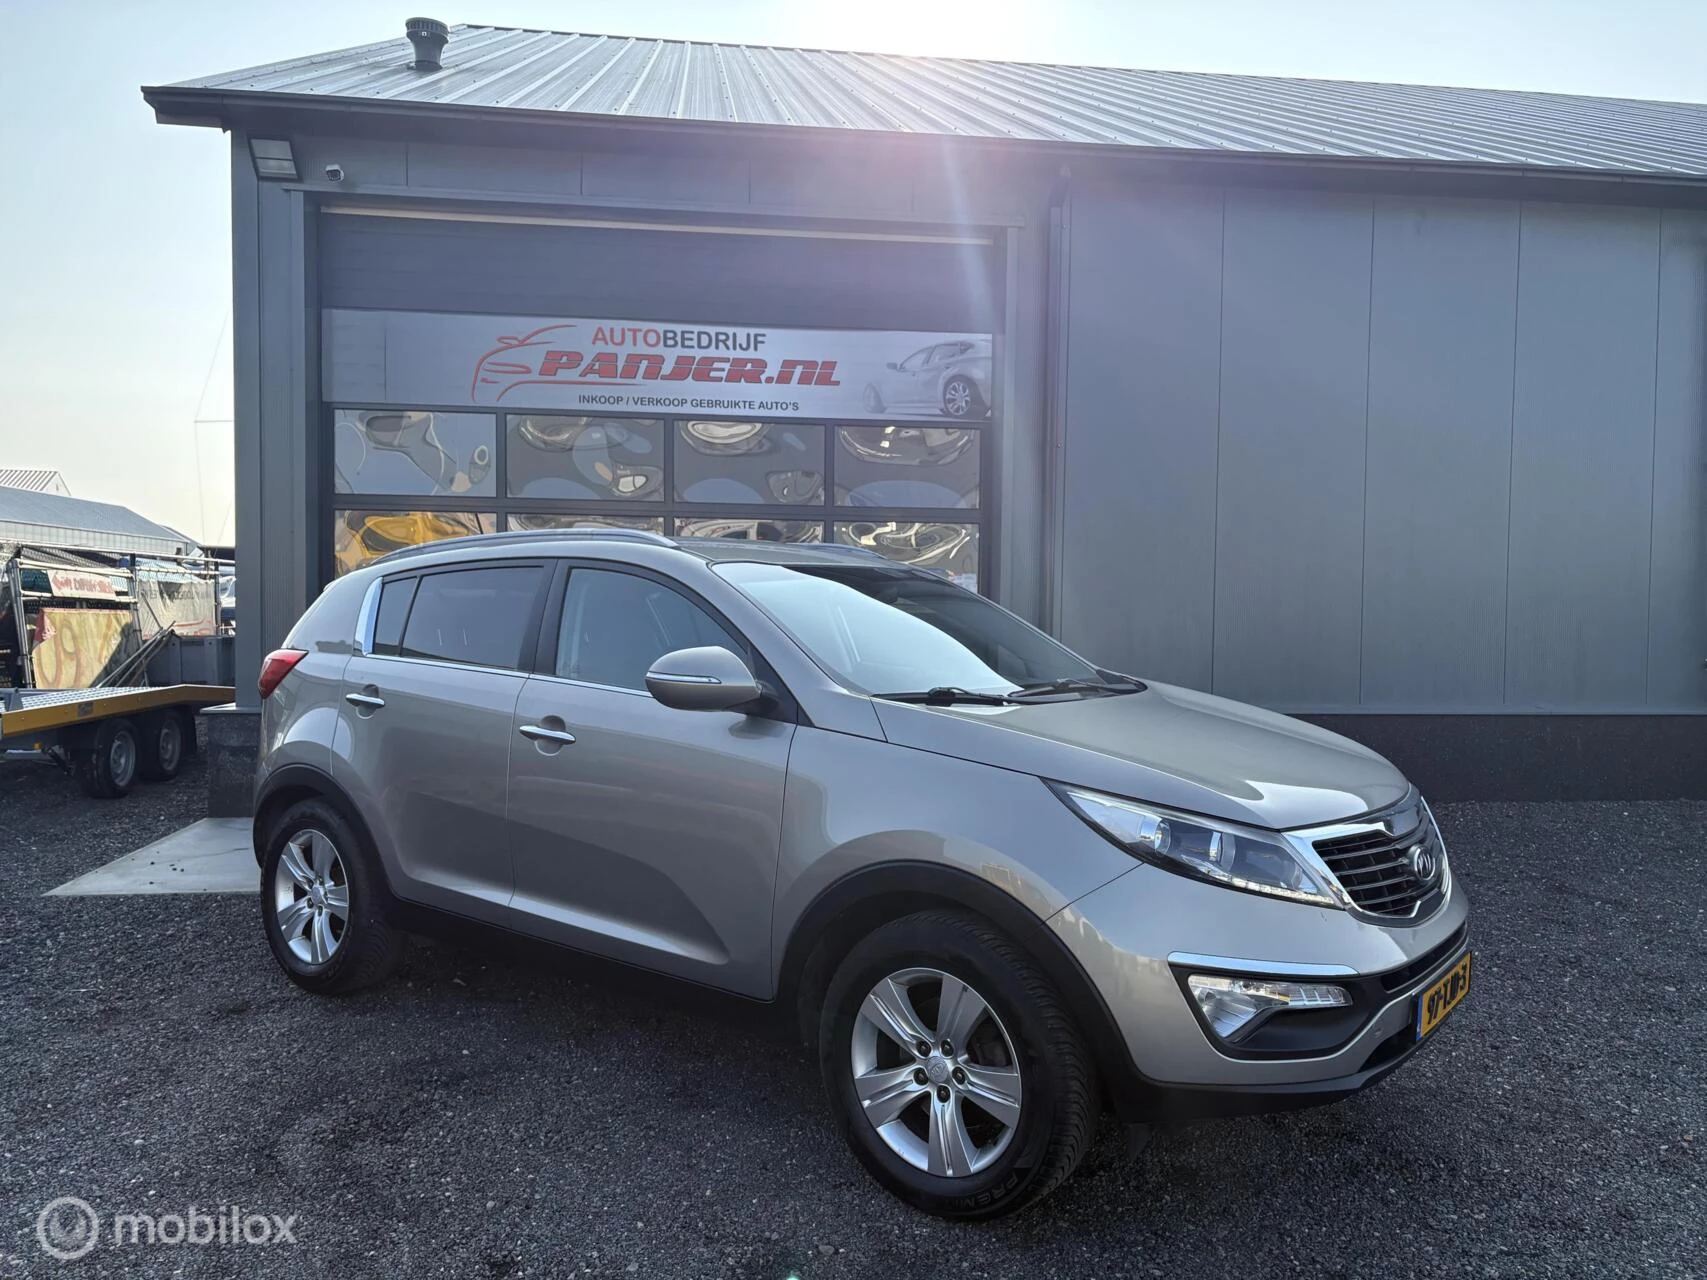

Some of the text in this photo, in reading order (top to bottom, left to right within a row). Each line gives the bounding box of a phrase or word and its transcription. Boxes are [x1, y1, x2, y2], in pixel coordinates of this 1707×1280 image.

[591, 326, 767, 352] AUTOBEDRIJF
[578, 394, 624, 405] INKOOP
[632, 396, 688, 408] VERKOOP
[690, 398, 756, 410] GEBRUIKTE
[758, 400, 800, 411] AUTO'S
